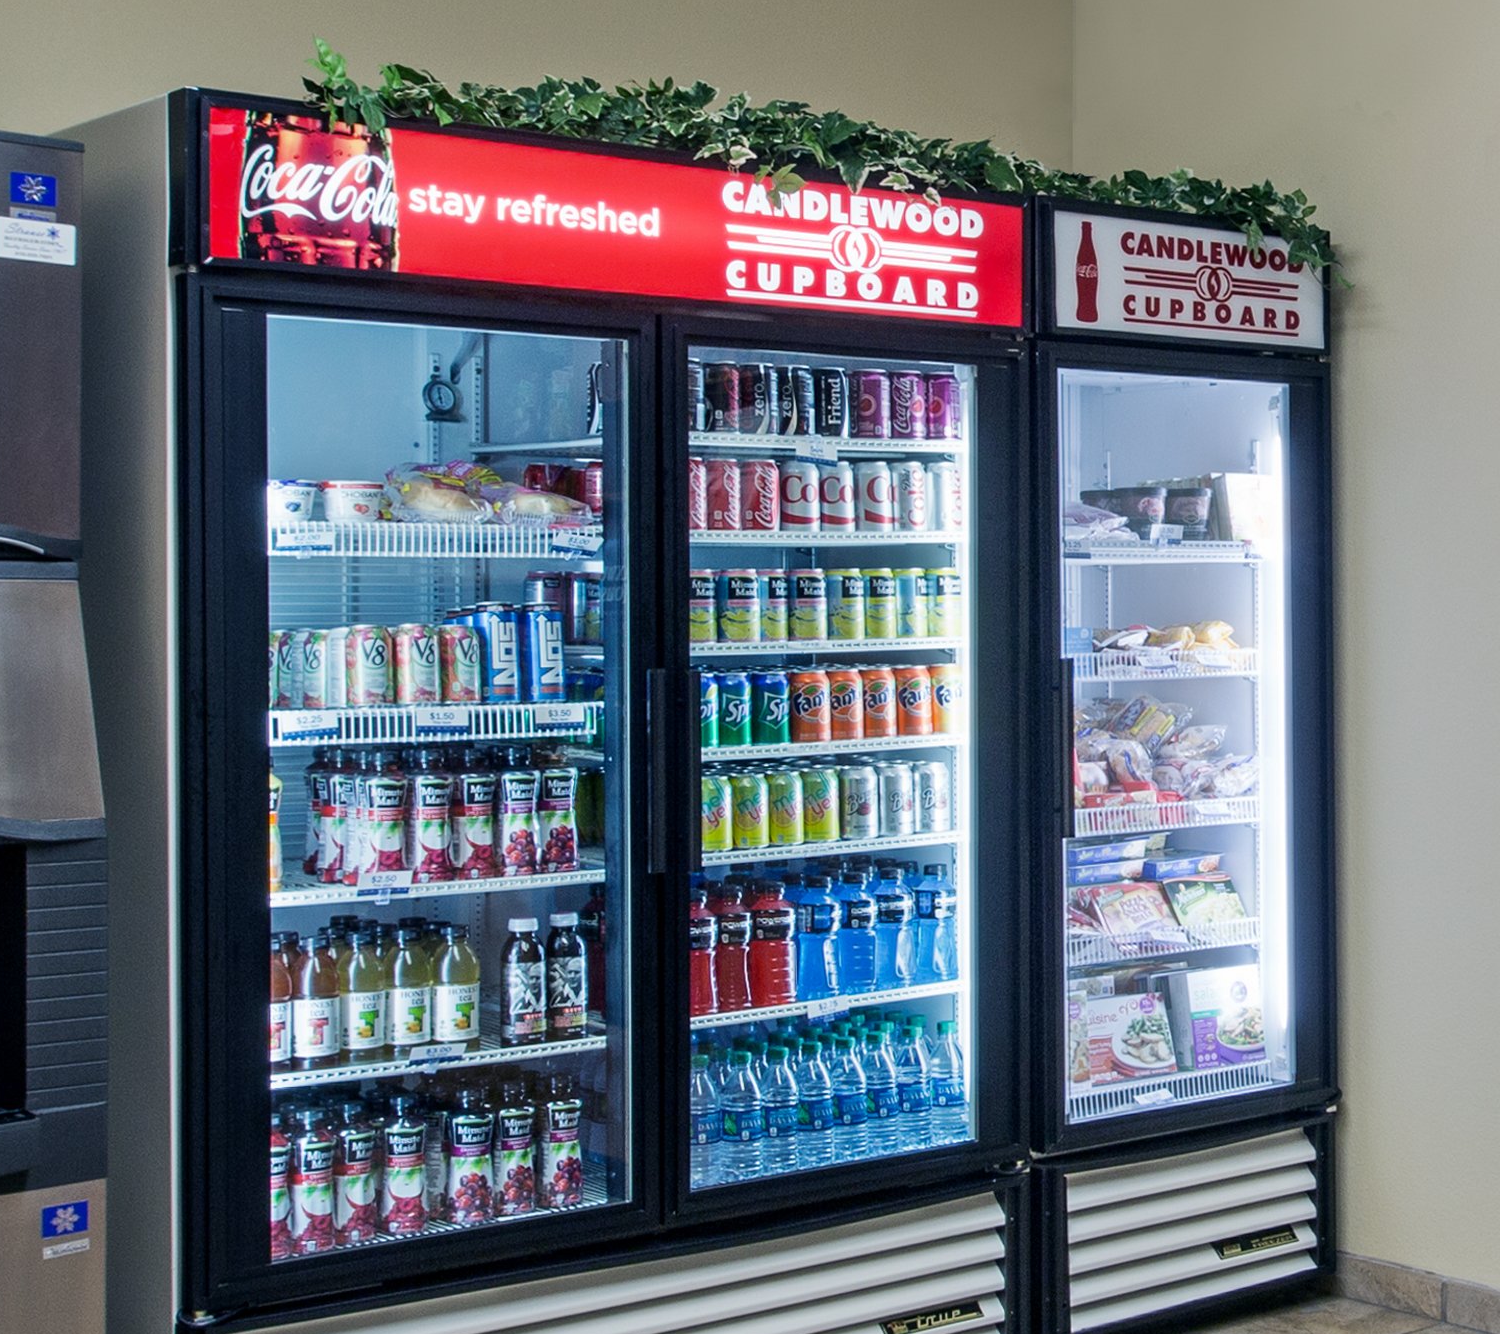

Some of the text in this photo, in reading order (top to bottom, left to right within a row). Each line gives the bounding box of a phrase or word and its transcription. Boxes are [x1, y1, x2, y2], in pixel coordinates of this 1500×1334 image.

[240, 143, 661, 238] Coca-Cola stay refreshed
[721, 182, 985, 239] CANDLEWOOD
[1120, 230, 1306, 272] CANDLEWOOD
[725, 259, 980, 310] CUPBOARD
[1122, 294, 1301, 331] CUPBOARD
[754, 383, 766, 419] zero
[827, 378, 843, 427] Friend
[363, 638, 386, 666] V8
[493, 620, 517, 685] NOS
[429, 710, 456, 722] $1.50
[547, 708, 573, 718] $3.50
[370, 873, 398, 884] $2.50
[458, 993, 473, 1003] tea
[916, 1308, 963, 1331] true
